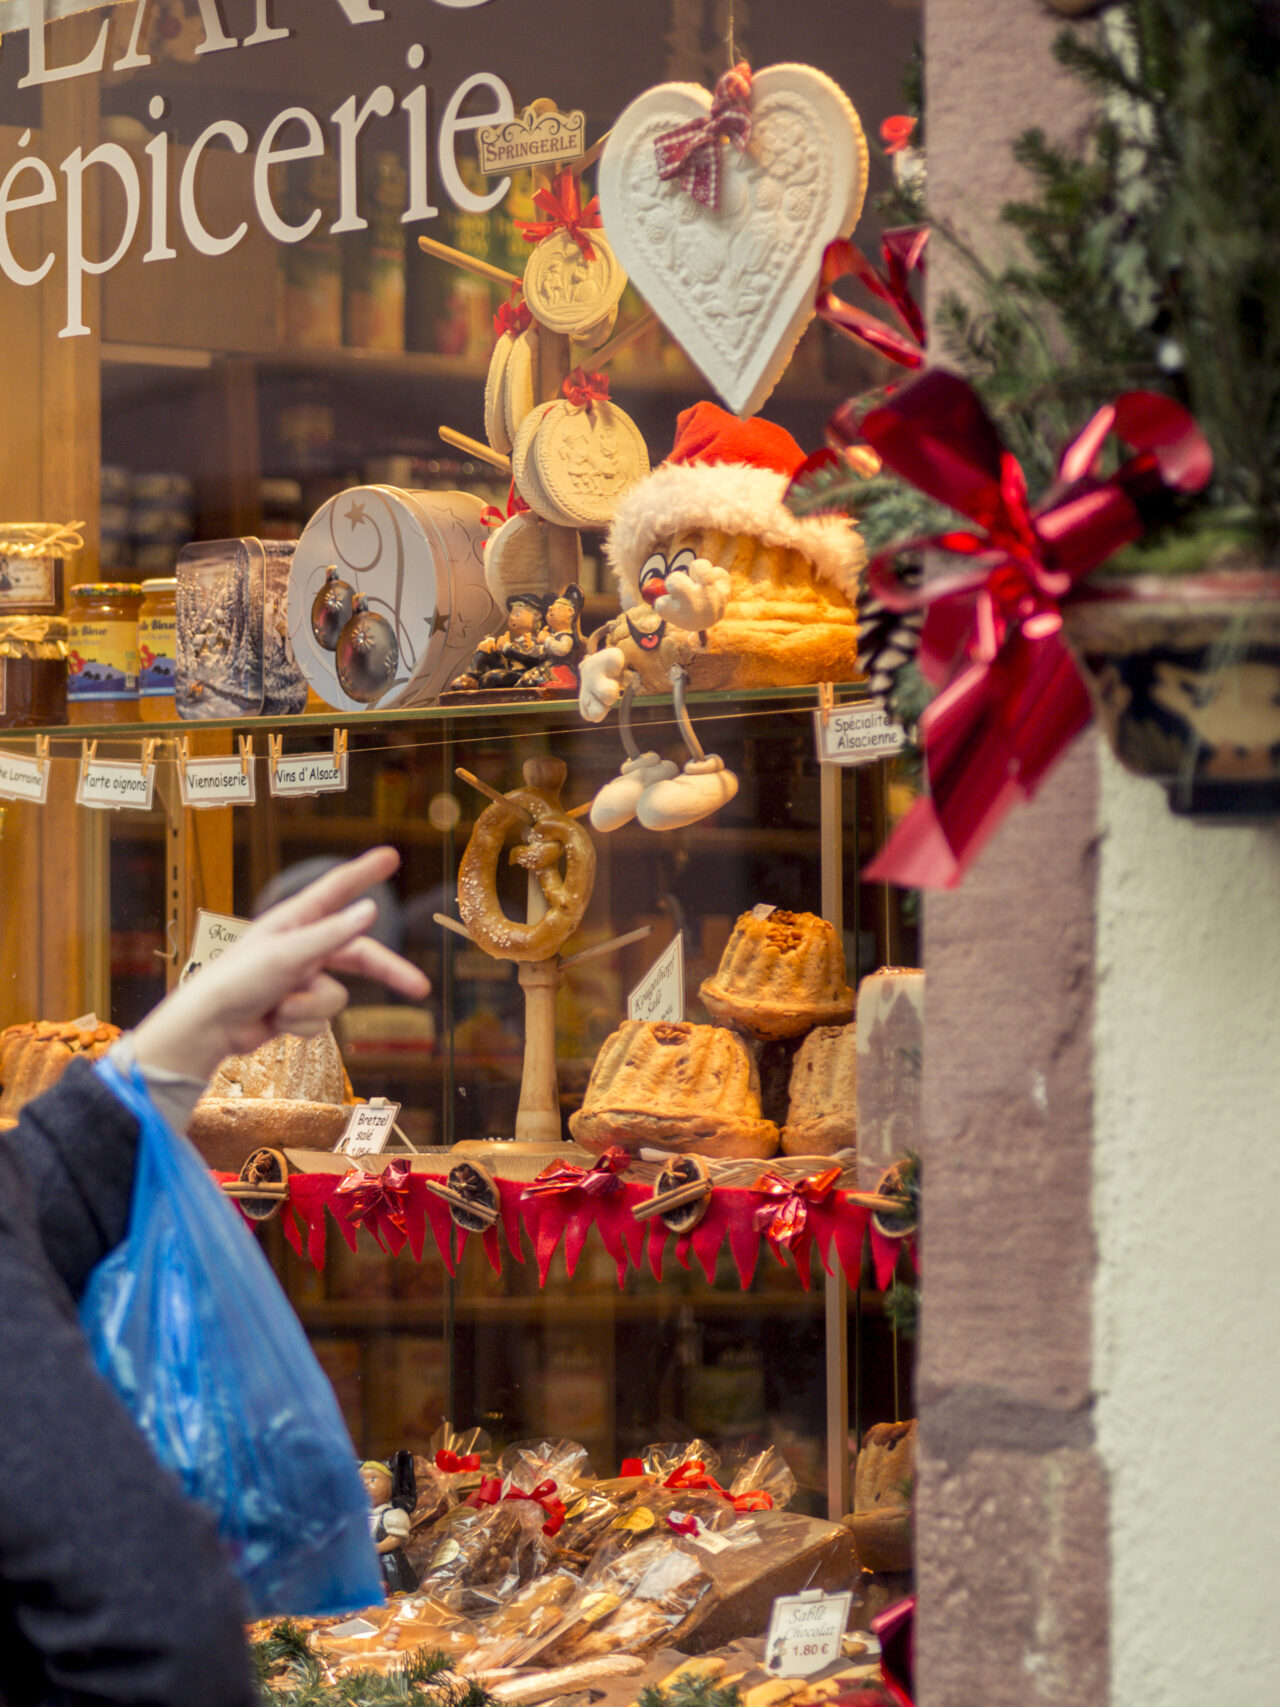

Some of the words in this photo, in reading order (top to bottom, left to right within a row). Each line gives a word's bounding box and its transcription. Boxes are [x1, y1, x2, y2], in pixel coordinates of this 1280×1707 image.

[486, 134, 577, 162] SPRINGERLE
[837, 731, 898, 751] Alsacienne
[9, 768, 42, 786] Lorraine
[113, 776, 147, 794] oignons
[187, 771, 247, 789] Viennoiserie
[276, 769, 296, 783] Vins
[357, 1113, 390, 1126] Bretzel
[793, 1644, 818, 1656] 1.80
[821, 1643, 829, 1655] €
